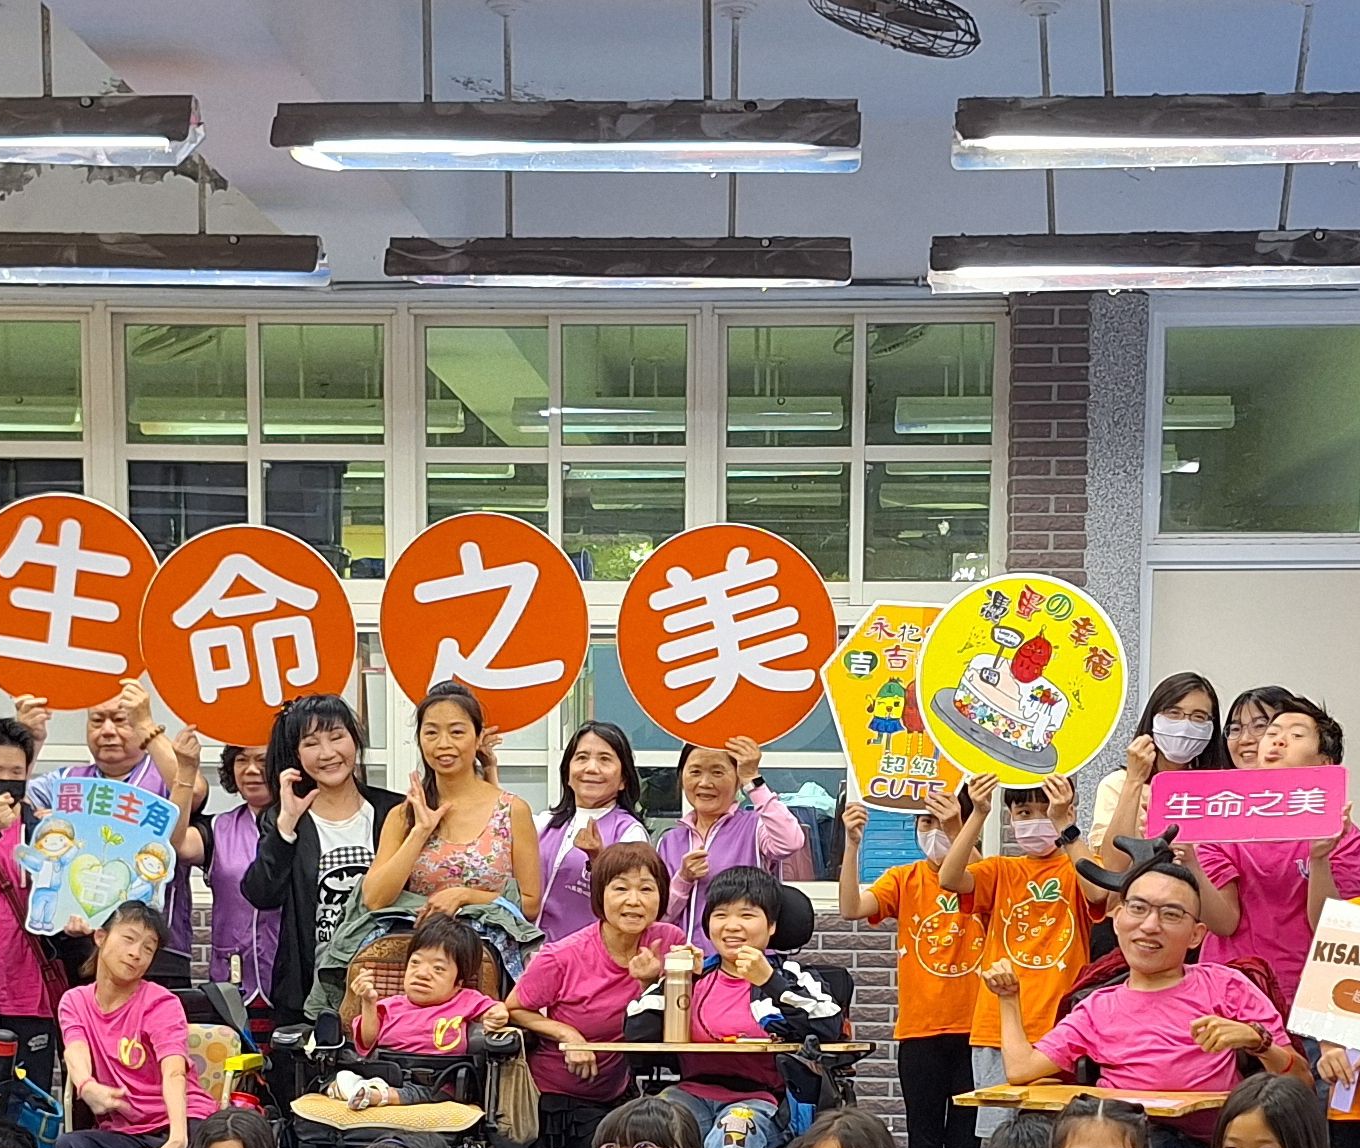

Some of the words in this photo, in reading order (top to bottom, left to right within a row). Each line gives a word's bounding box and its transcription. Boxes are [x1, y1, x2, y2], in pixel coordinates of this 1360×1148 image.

[880, 755, 937, 777] 超級
[56, 782, 171, 837] 最佳主角
[1164, 786, 1328, 820] 生命之美
